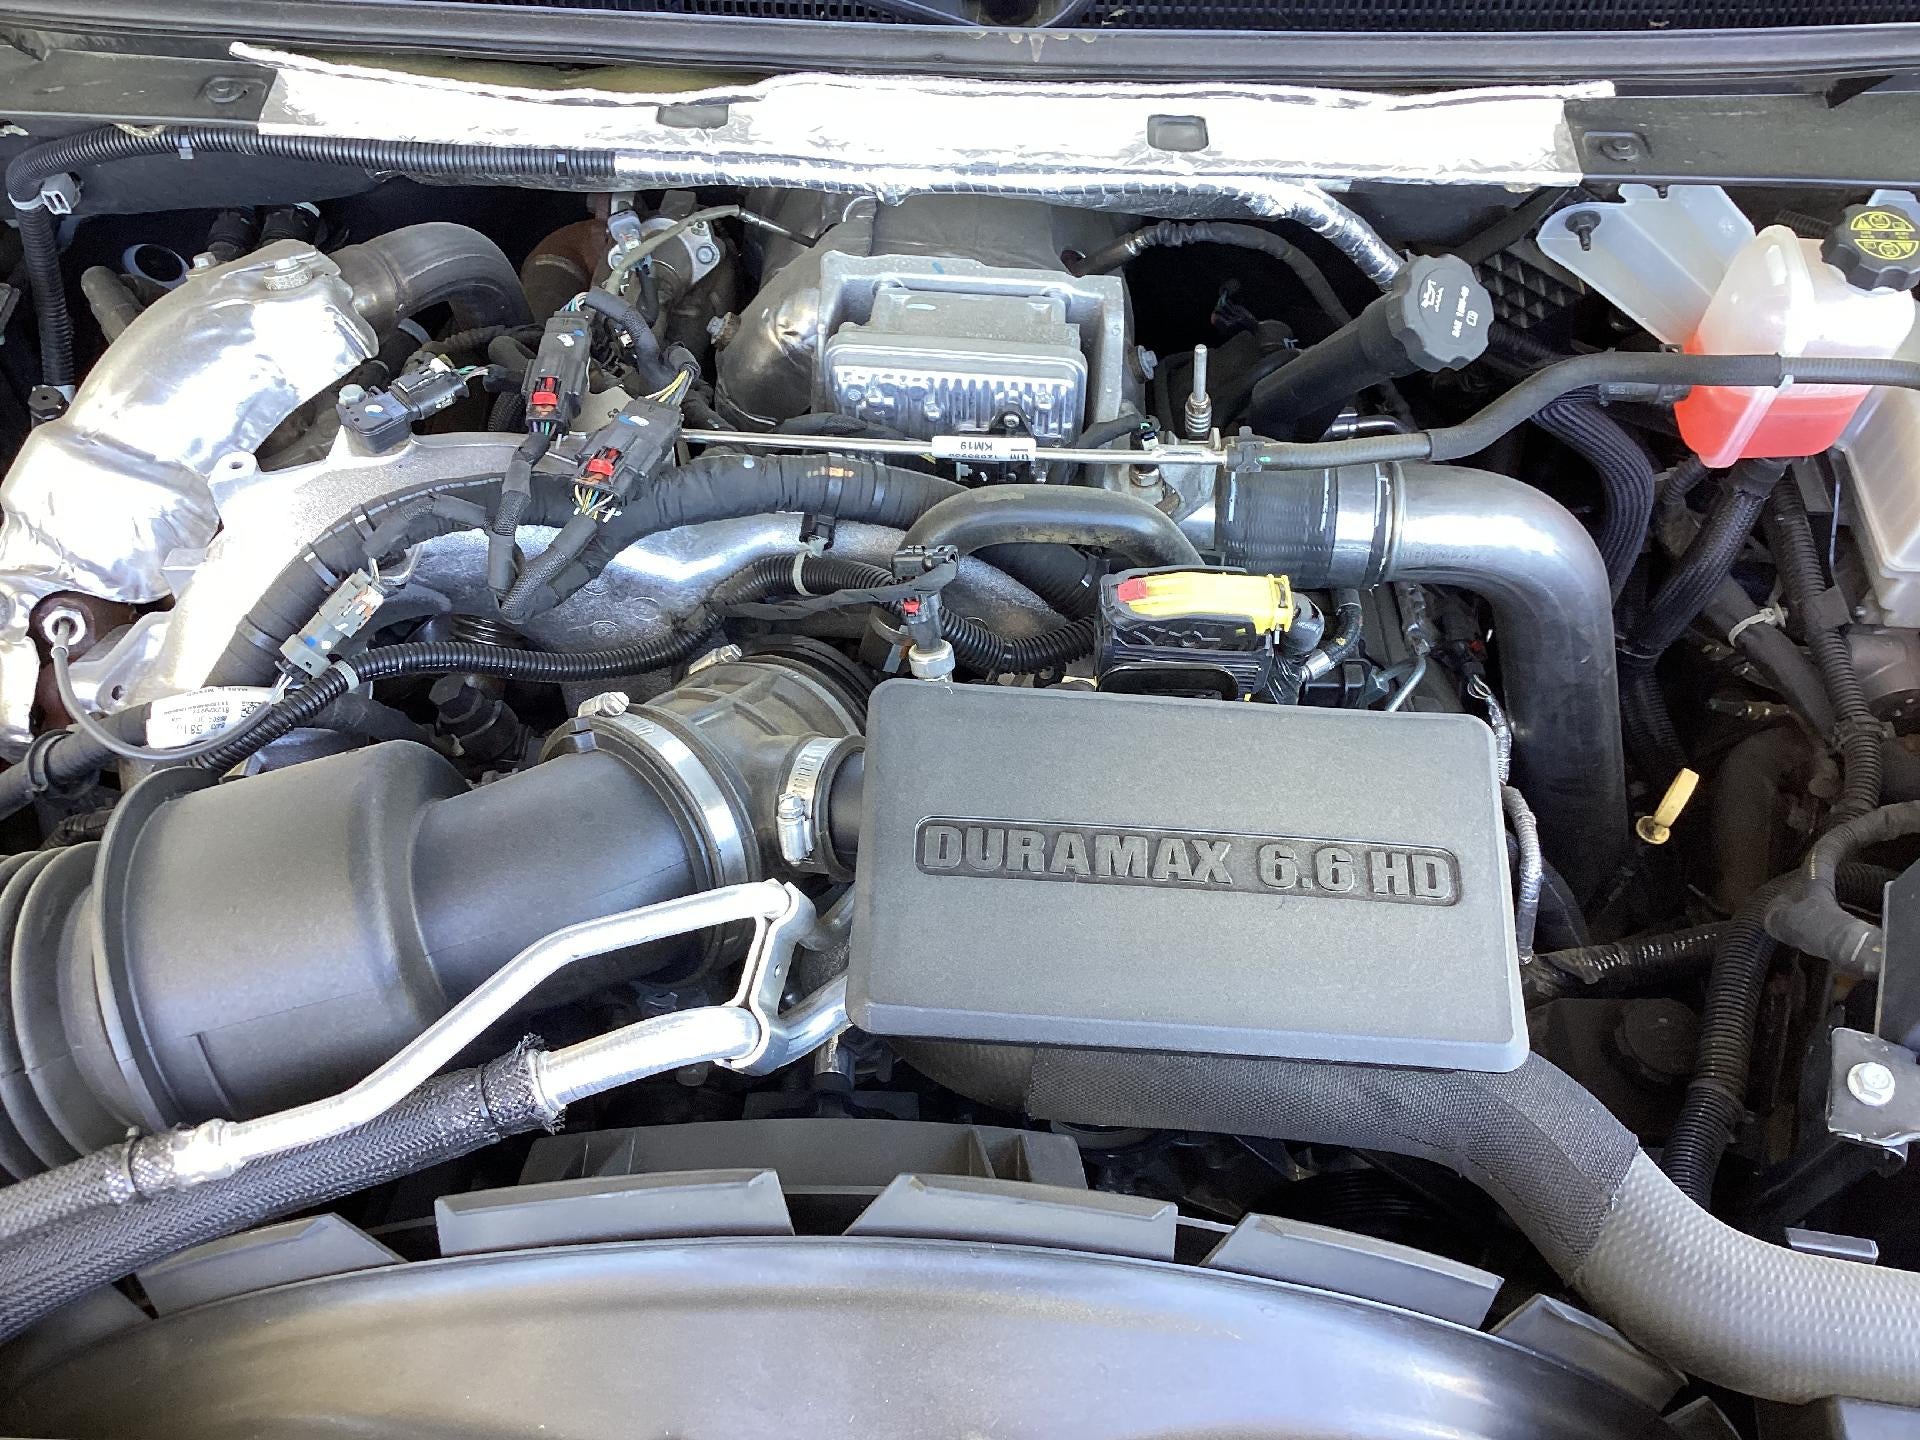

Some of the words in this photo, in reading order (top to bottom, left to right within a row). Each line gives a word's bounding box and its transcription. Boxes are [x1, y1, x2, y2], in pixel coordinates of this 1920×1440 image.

[960, 441, 993, 452] KM19
[924, 825, 1233, 885] DURAMAX
[1259, 843, 1355, 893] 6.6
[1370, 851, 1451, 900] HD
